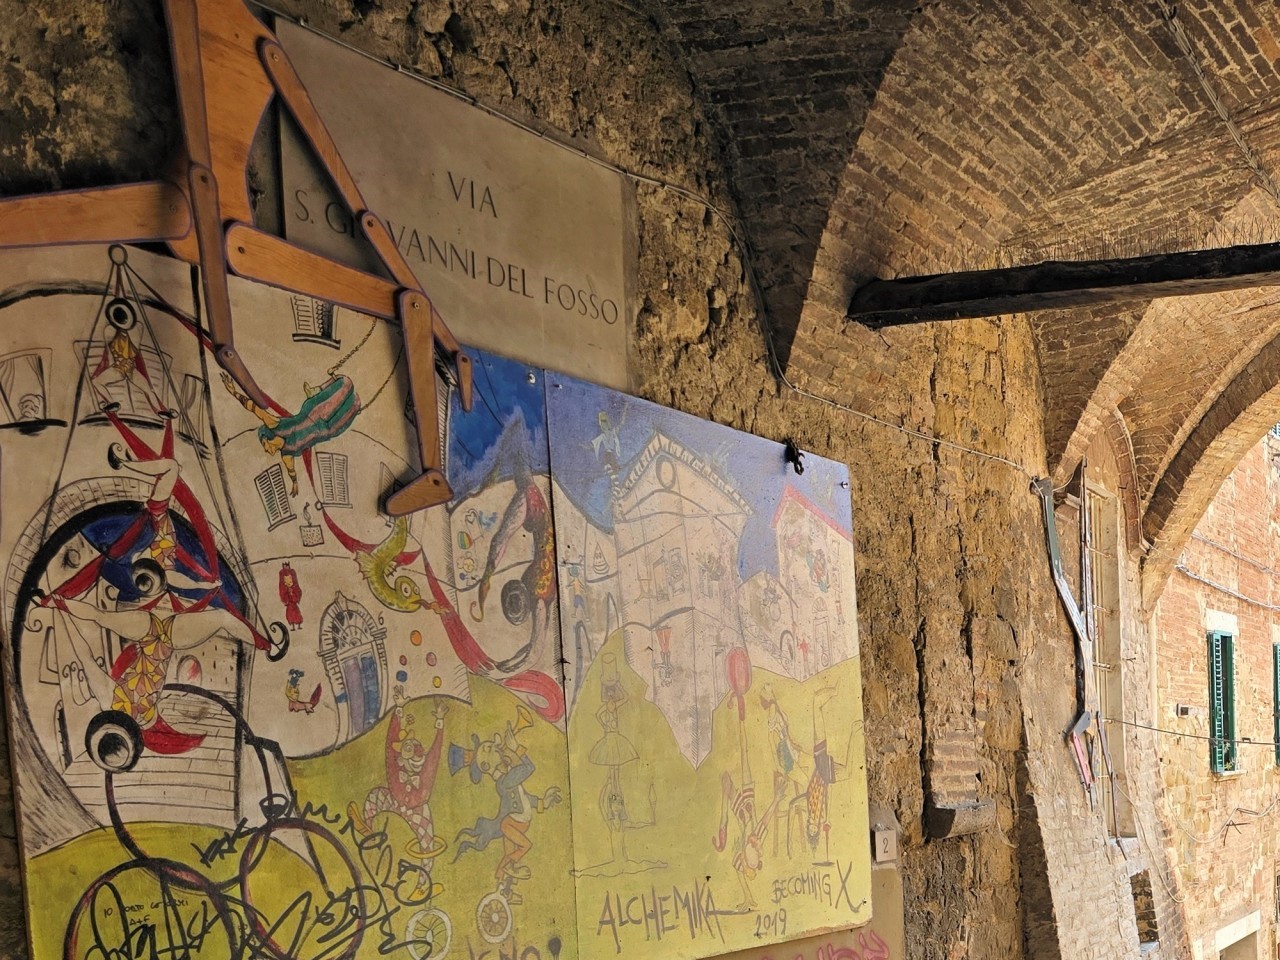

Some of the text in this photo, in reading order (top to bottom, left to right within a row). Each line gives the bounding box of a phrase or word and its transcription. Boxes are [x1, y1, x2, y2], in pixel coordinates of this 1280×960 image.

[447, 170, 498, 219] VIA
[294, 189, 619, 325] S. GIVANNI DEL FOSSO
[882, 837, 889, 854] 2
[771, 872, 832, 907] BECOMING
[597, 878, 727, 954] ALCHEMIKA
[754, 908, 789, 940] 2019
